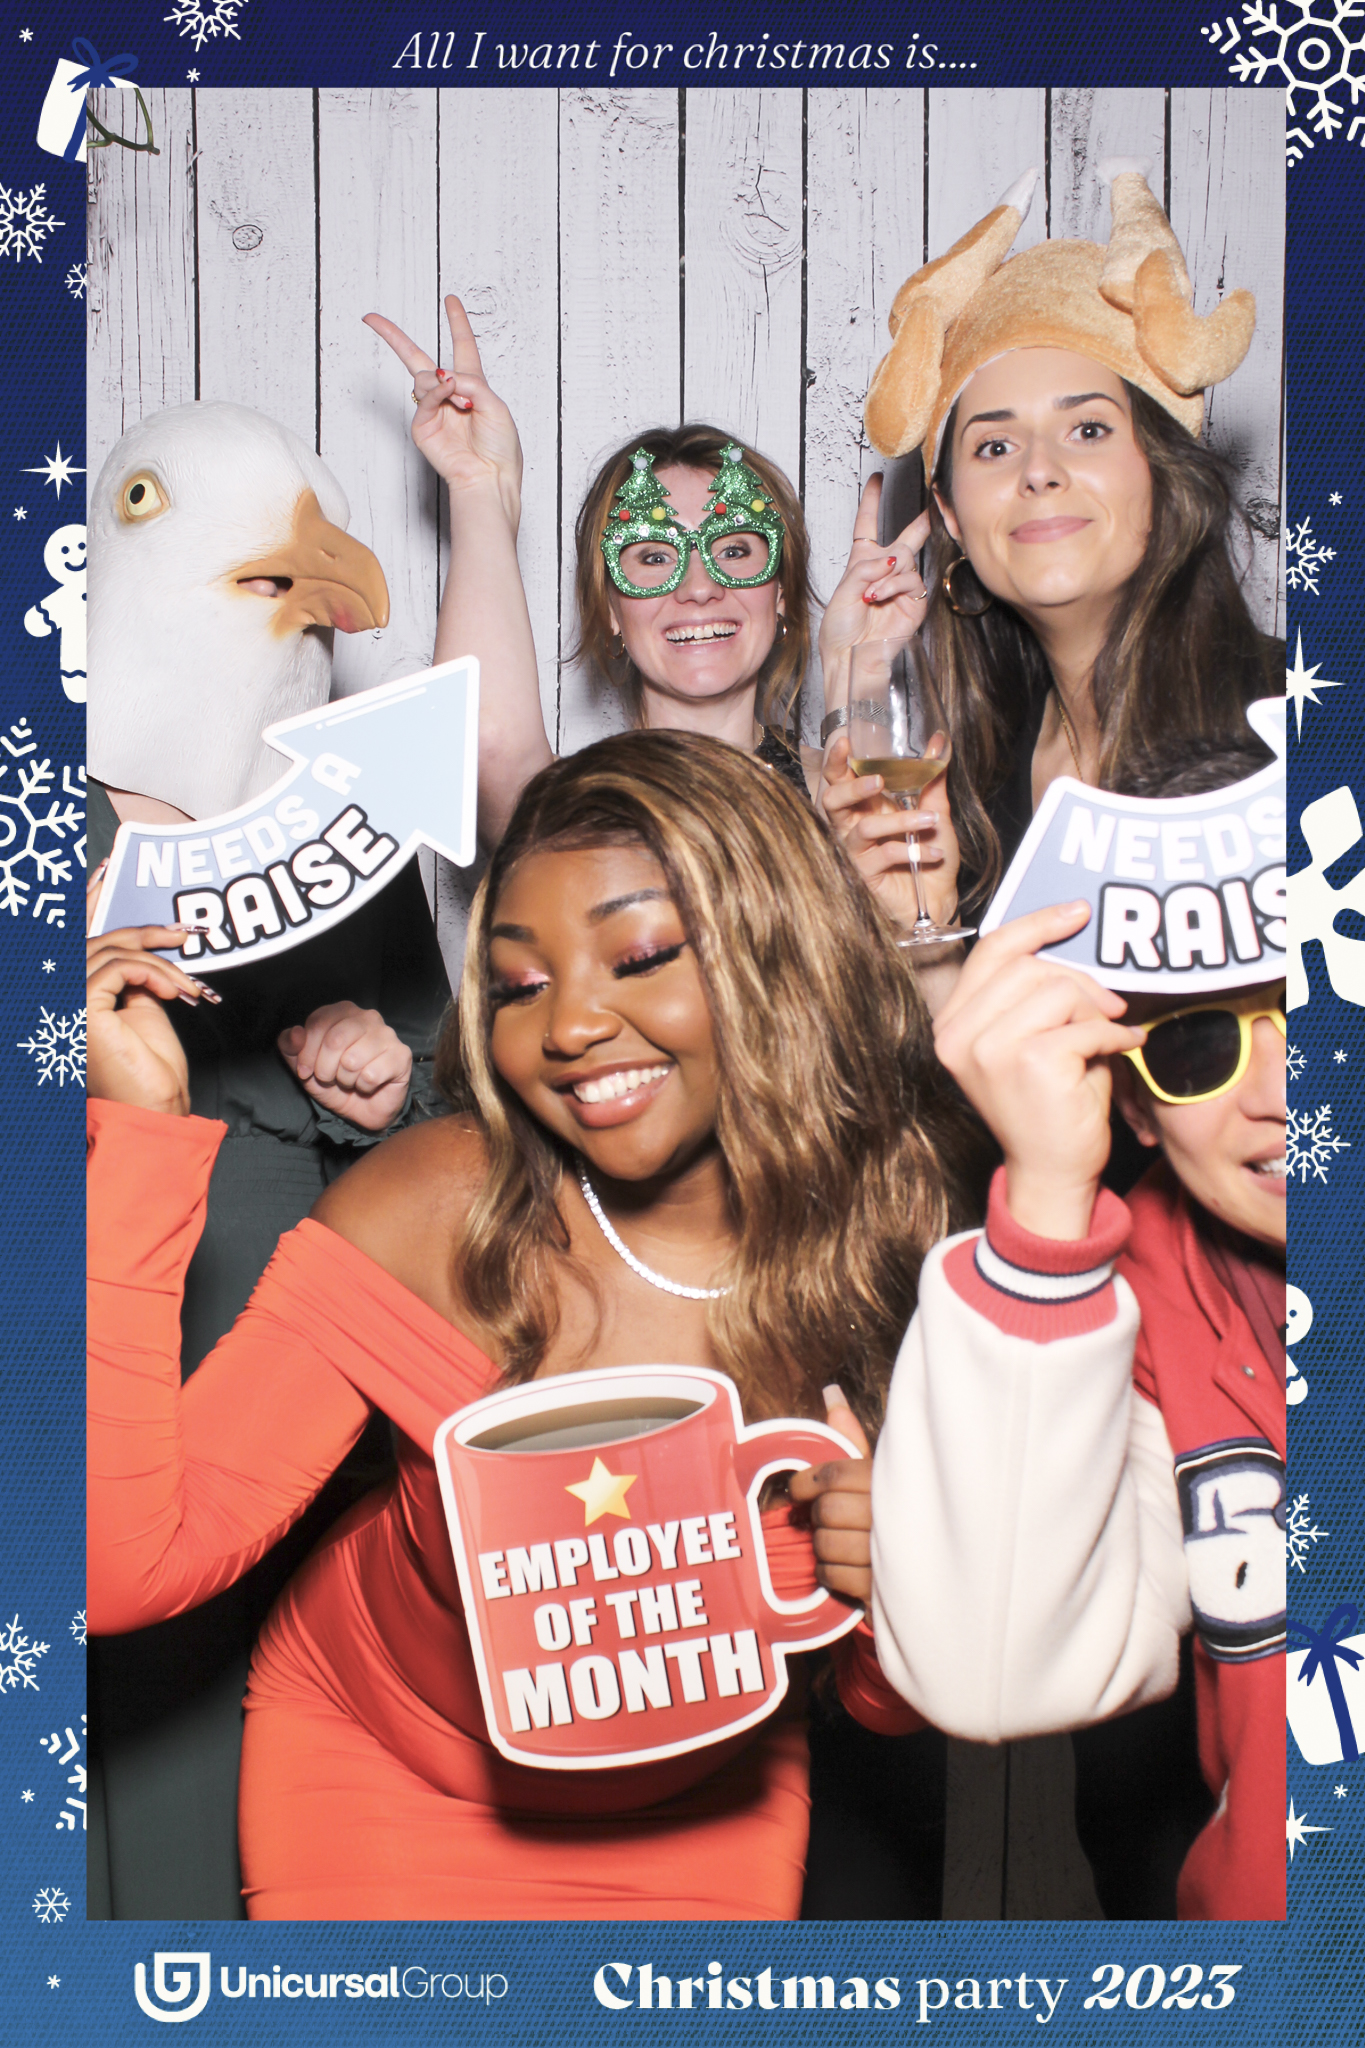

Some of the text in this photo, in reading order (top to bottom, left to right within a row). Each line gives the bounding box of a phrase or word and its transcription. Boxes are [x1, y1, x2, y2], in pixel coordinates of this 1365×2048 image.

[135, 752, 362, 888] NEEDS A
[1059, 795, 1286, 881] NEEDS
[174, 804, 399, 959] RAISE
[478, 1511, 743, 1600] EMPLOYEE
[533, 1579, 709, 1652] OF THE
[502, 1629, 765, 1733] MONTH
